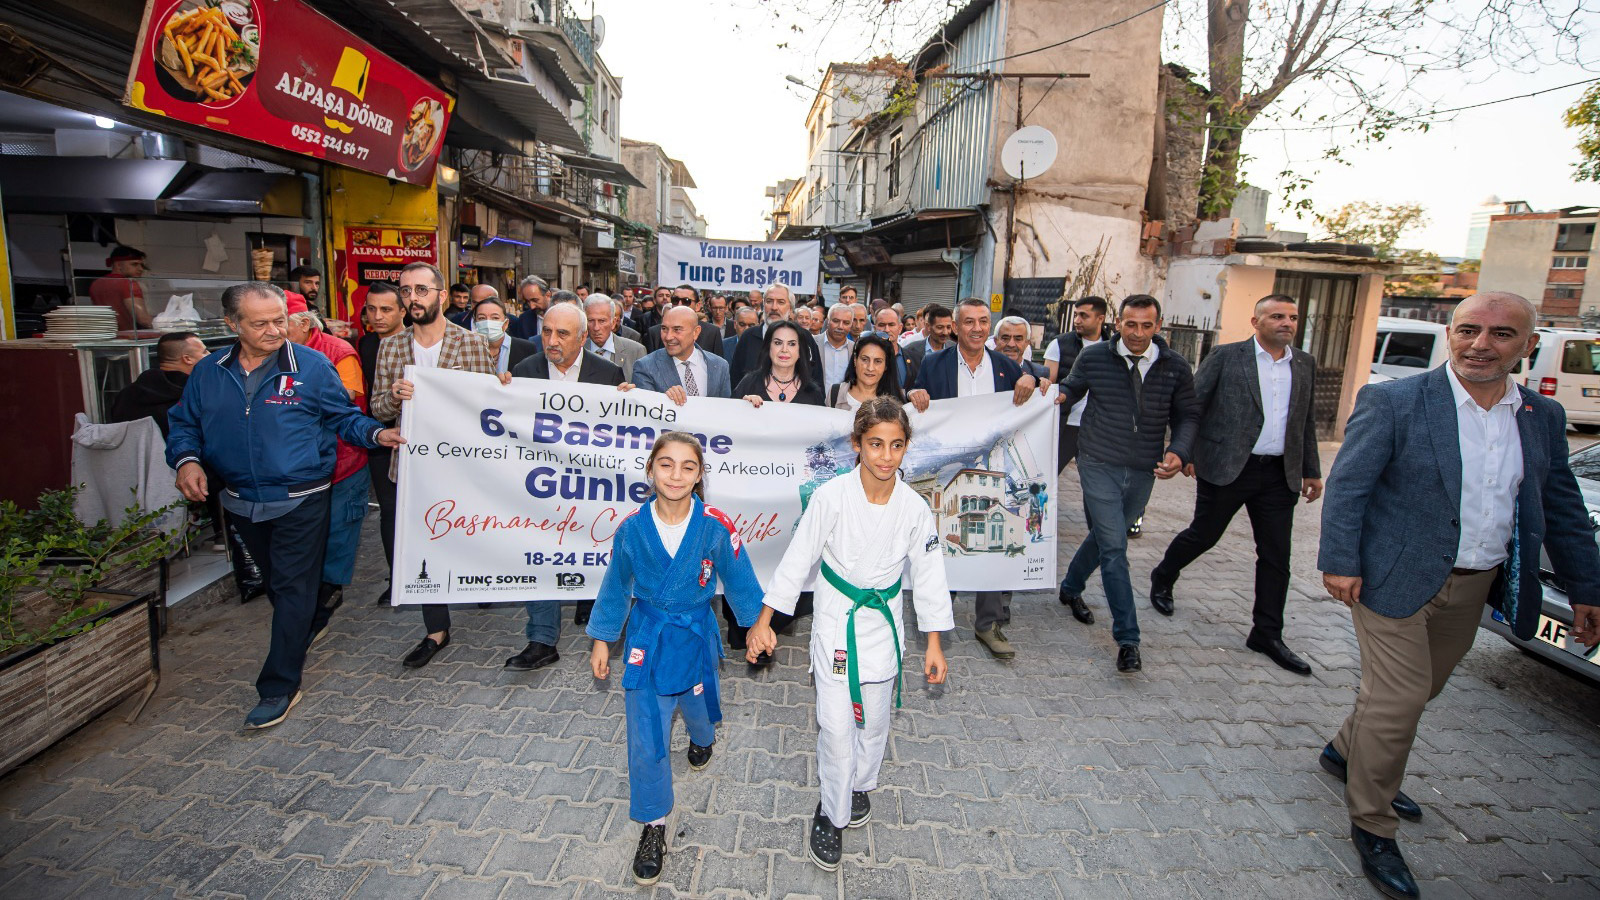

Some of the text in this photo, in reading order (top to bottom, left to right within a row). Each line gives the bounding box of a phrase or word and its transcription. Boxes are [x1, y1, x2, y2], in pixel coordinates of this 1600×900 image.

[275, 71, 393, 136] ALPAŞA DÖNER
[291, 124, 370, 160] 0552 524 56 77
[351, 246, 432, 258] ALPAŞA DÖNER
[699, 241, 784, 262] Yanındayız
[364, 269, 389, 280] KEBAP
[677, 261, 725, 286] Tunç
[730, 263, 803, 288] Başkan
[539, 392, 677, 422] 100. yılında
[479, 408, 733, 454] 6. Basmne
[407, 443, 429, 456] ve
[436, 441, 508, 459] Çevresi
[515, 445, 563, 464] Tarih,
[568, 452, 627, 472] Kültür,
[718, 461, 796, 477] Arkeoloji
[424, 499, 585, 545] Basmane'de
[524, 551, 608, 566] 18-24 EK
[457, 575, 538, 587] TUNÇ SOYER
